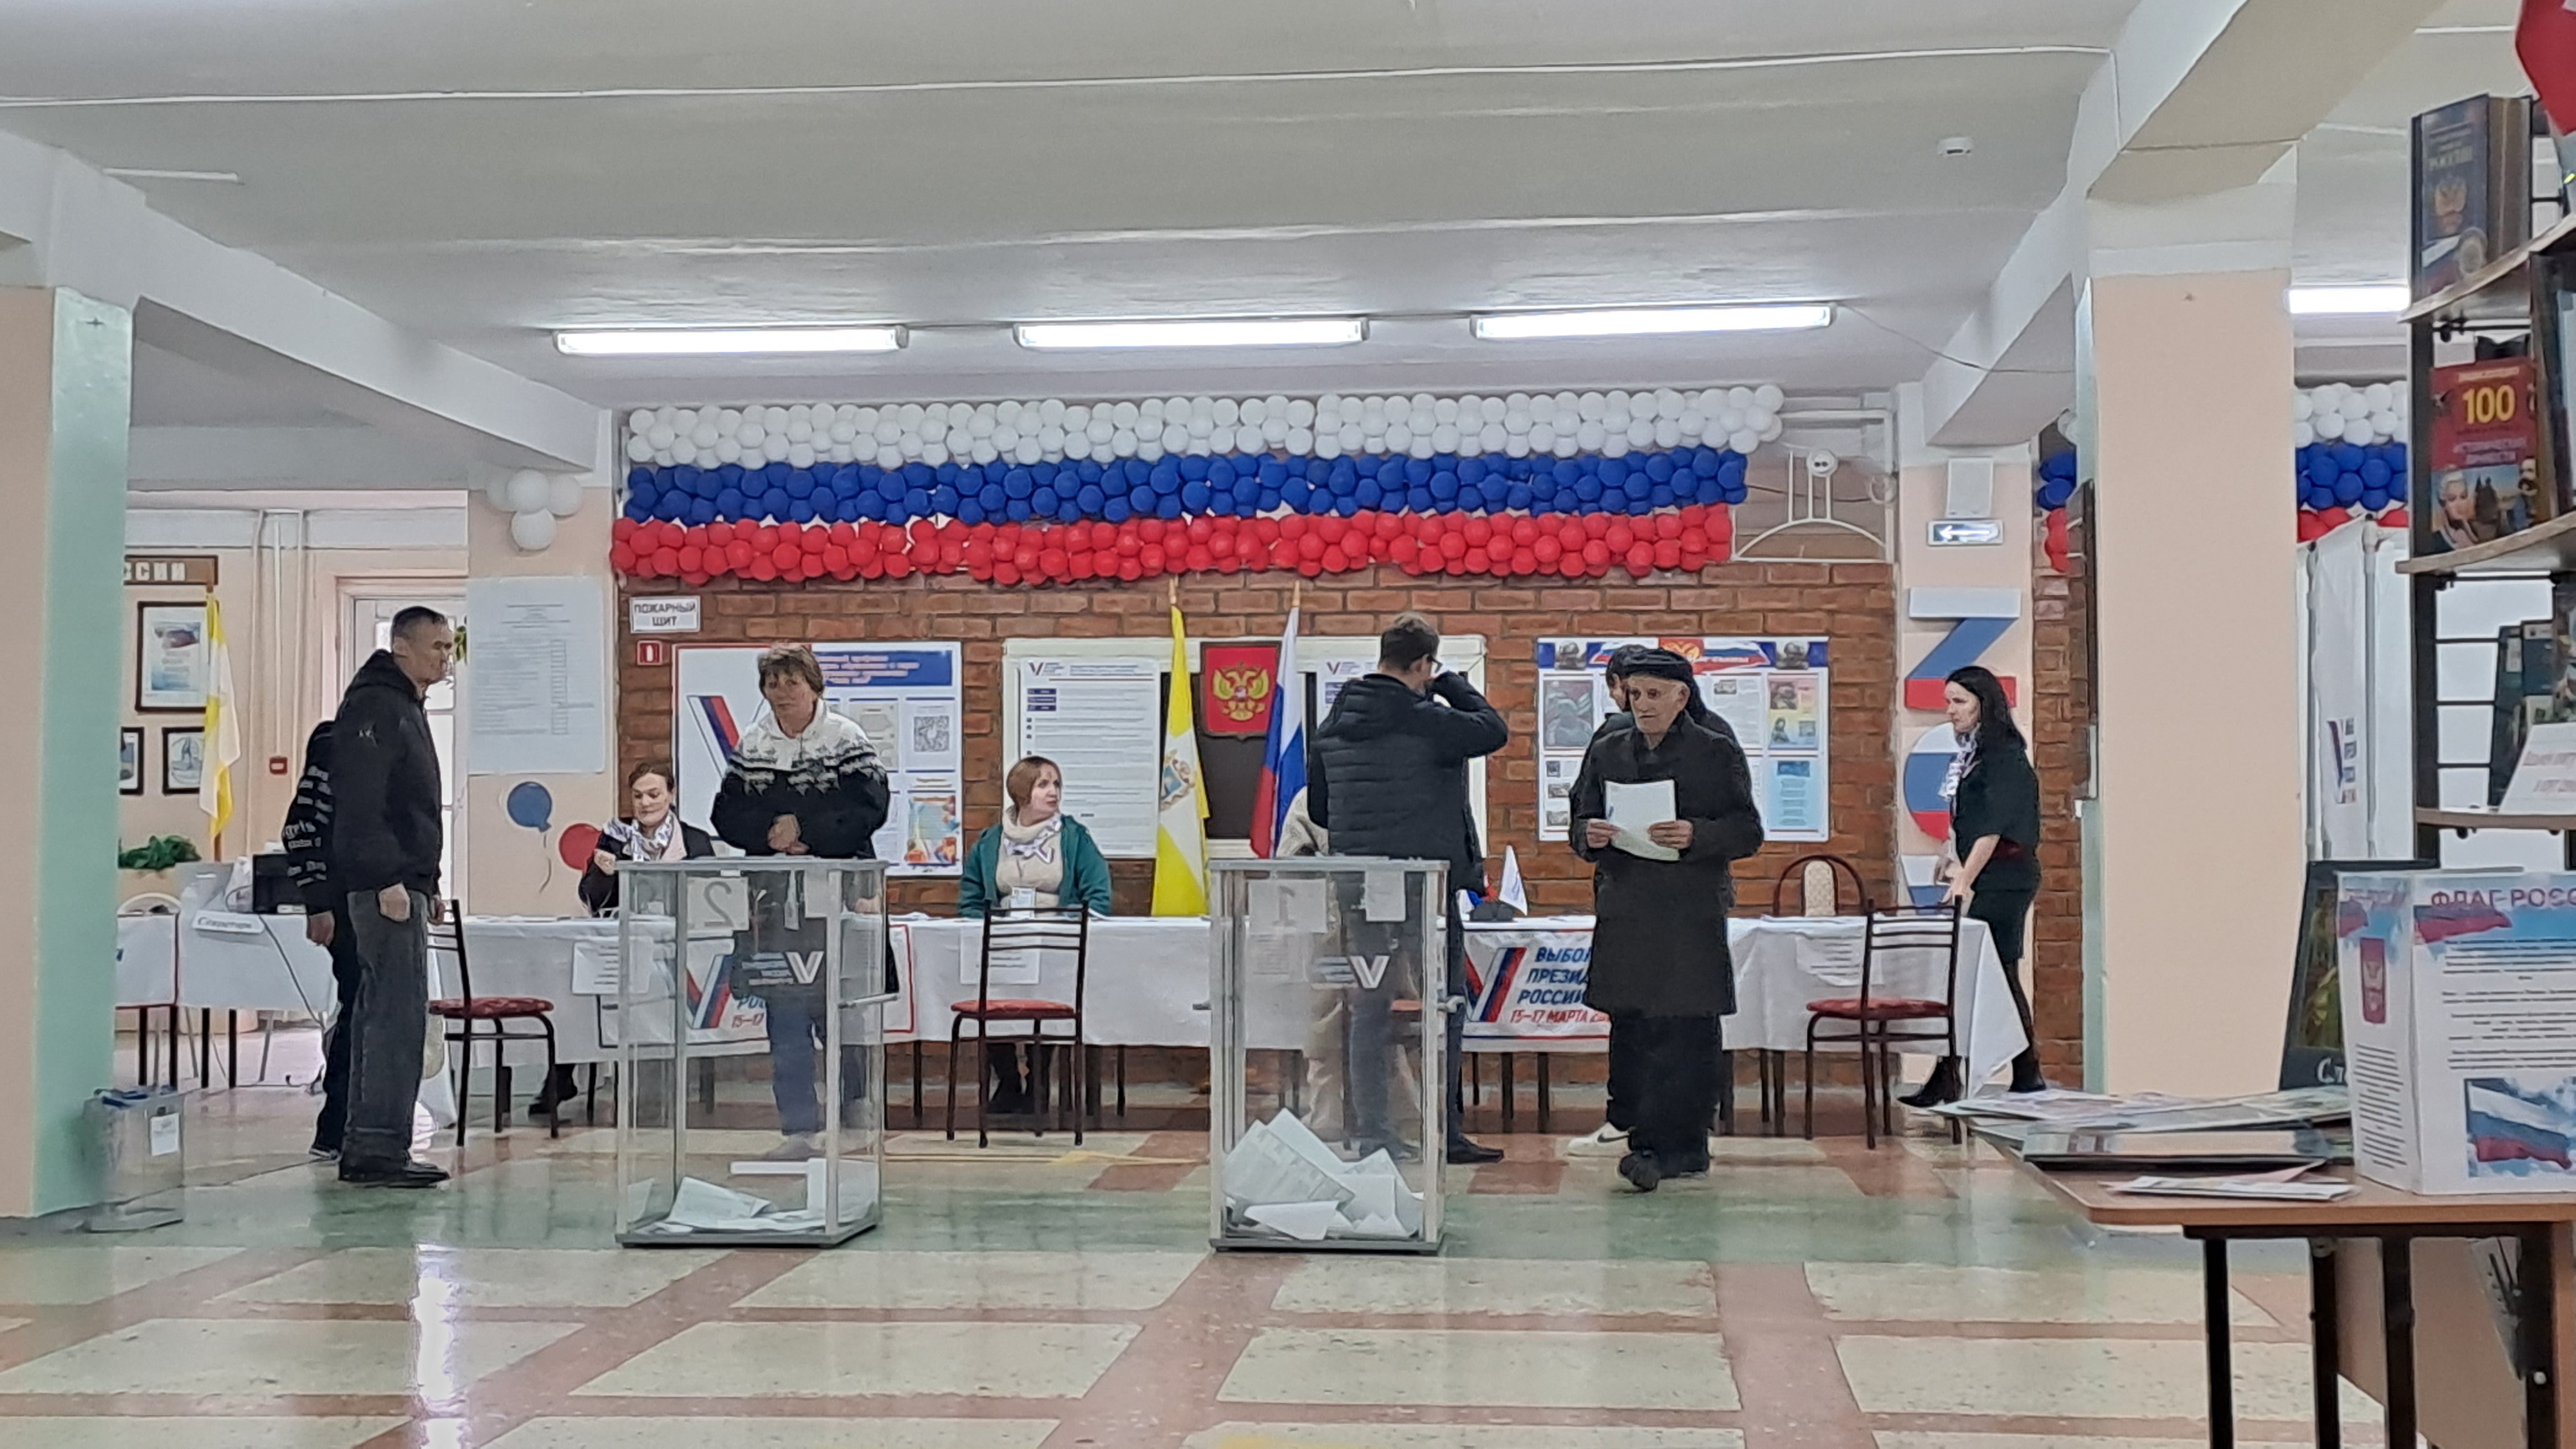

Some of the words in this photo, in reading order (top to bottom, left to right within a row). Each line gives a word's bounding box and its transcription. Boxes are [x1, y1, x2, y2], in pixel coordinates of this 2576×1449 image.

[2463, 384, 2515, 424] 100
[634, 601, 696, 613] ПОЖАРНЫЙ
[2431, 889, 2503, 906] ФЛАГ
[1547, 1009, 1587, 1023] МАРТА
